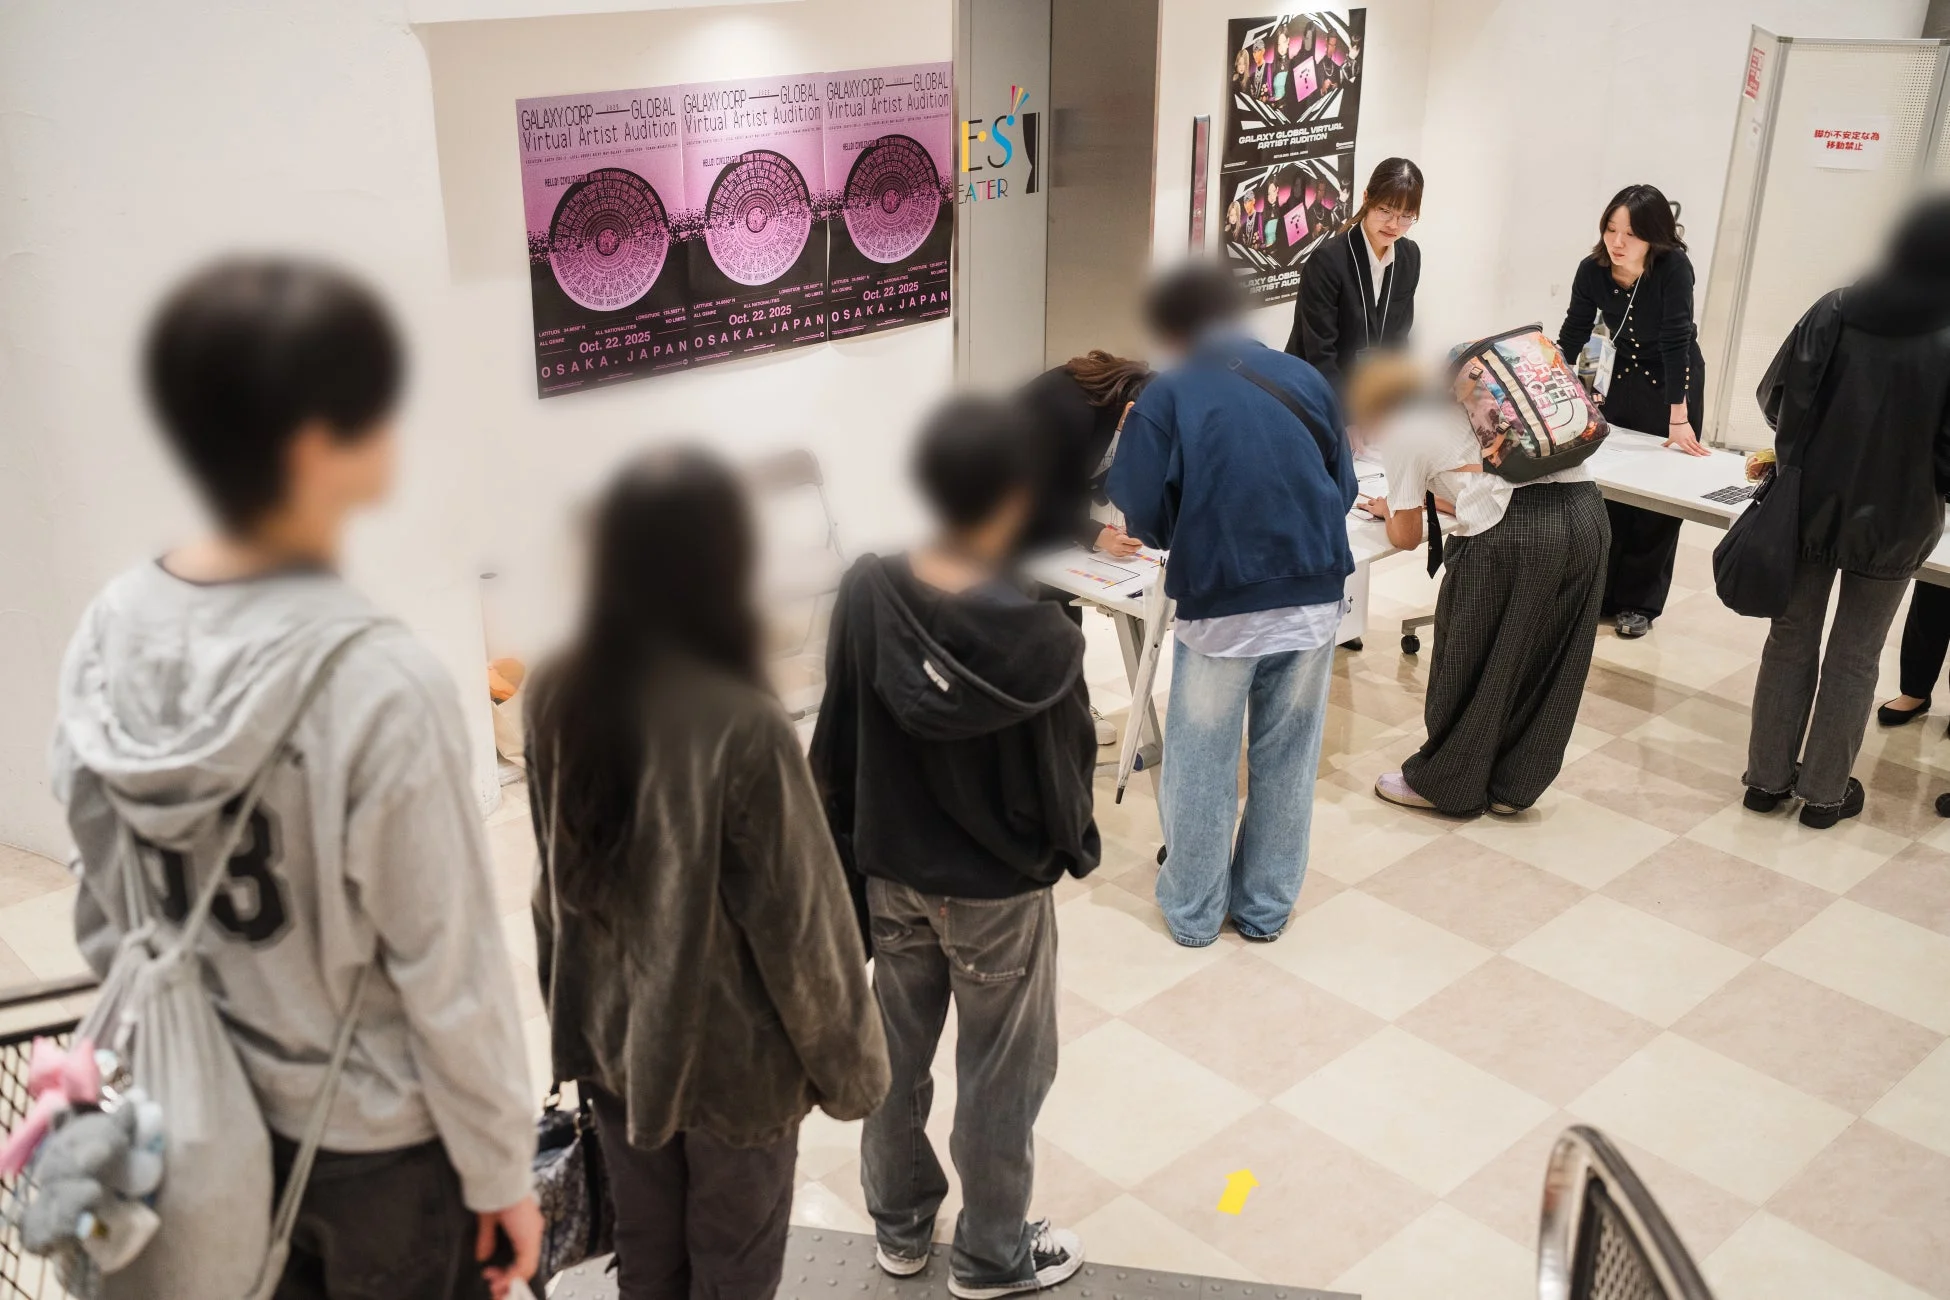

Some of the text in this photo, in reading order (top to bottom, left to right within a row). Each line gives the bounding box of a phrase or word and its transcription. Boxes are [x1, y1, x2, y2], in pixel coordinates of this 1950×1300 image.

[913, 72, 948, 91] GLOBAL
[781, 82, 819, 104] GLOBAL
[631, 97, 675, 119] GLOBAL
[827, 92, 949, 119] Virtual Artist Audition
[685, 112, 727, 133] Virtual
[733, 108, 768, 129] Artist
[773, 104, 820, 125] Audition
[523, 125, 572, 152] Virtual
[578, 122, 618, 147] Artist
[624, 120, 677, 142] Audition
[1239, 122, 1344, 144] GALAXY GLOBAL VIRTUAL
[1257, 133, 1328, 150] ARTIST AUDITION
[1814, 129, 1880, 141] 脚が不安定な為
[1826, 140, 1863, 151] 移動禁止
[1267, 270, 1300, 283] GLOBAL
[863, 281, 919, 301] Oct. 22. 2025
[899, 290, 948, 309] JAPAN
[729, 304, 792, 326] Oct. 22. 2025
[770, 314, 824, 334] JAPAN
[579, 331, 651, 354] Oct. 22. 2025
[627, 340, 687, 362] JAPAN
[1514, 359, 1553, 409] FACE
[1551, 363, 1580, 399] THE
